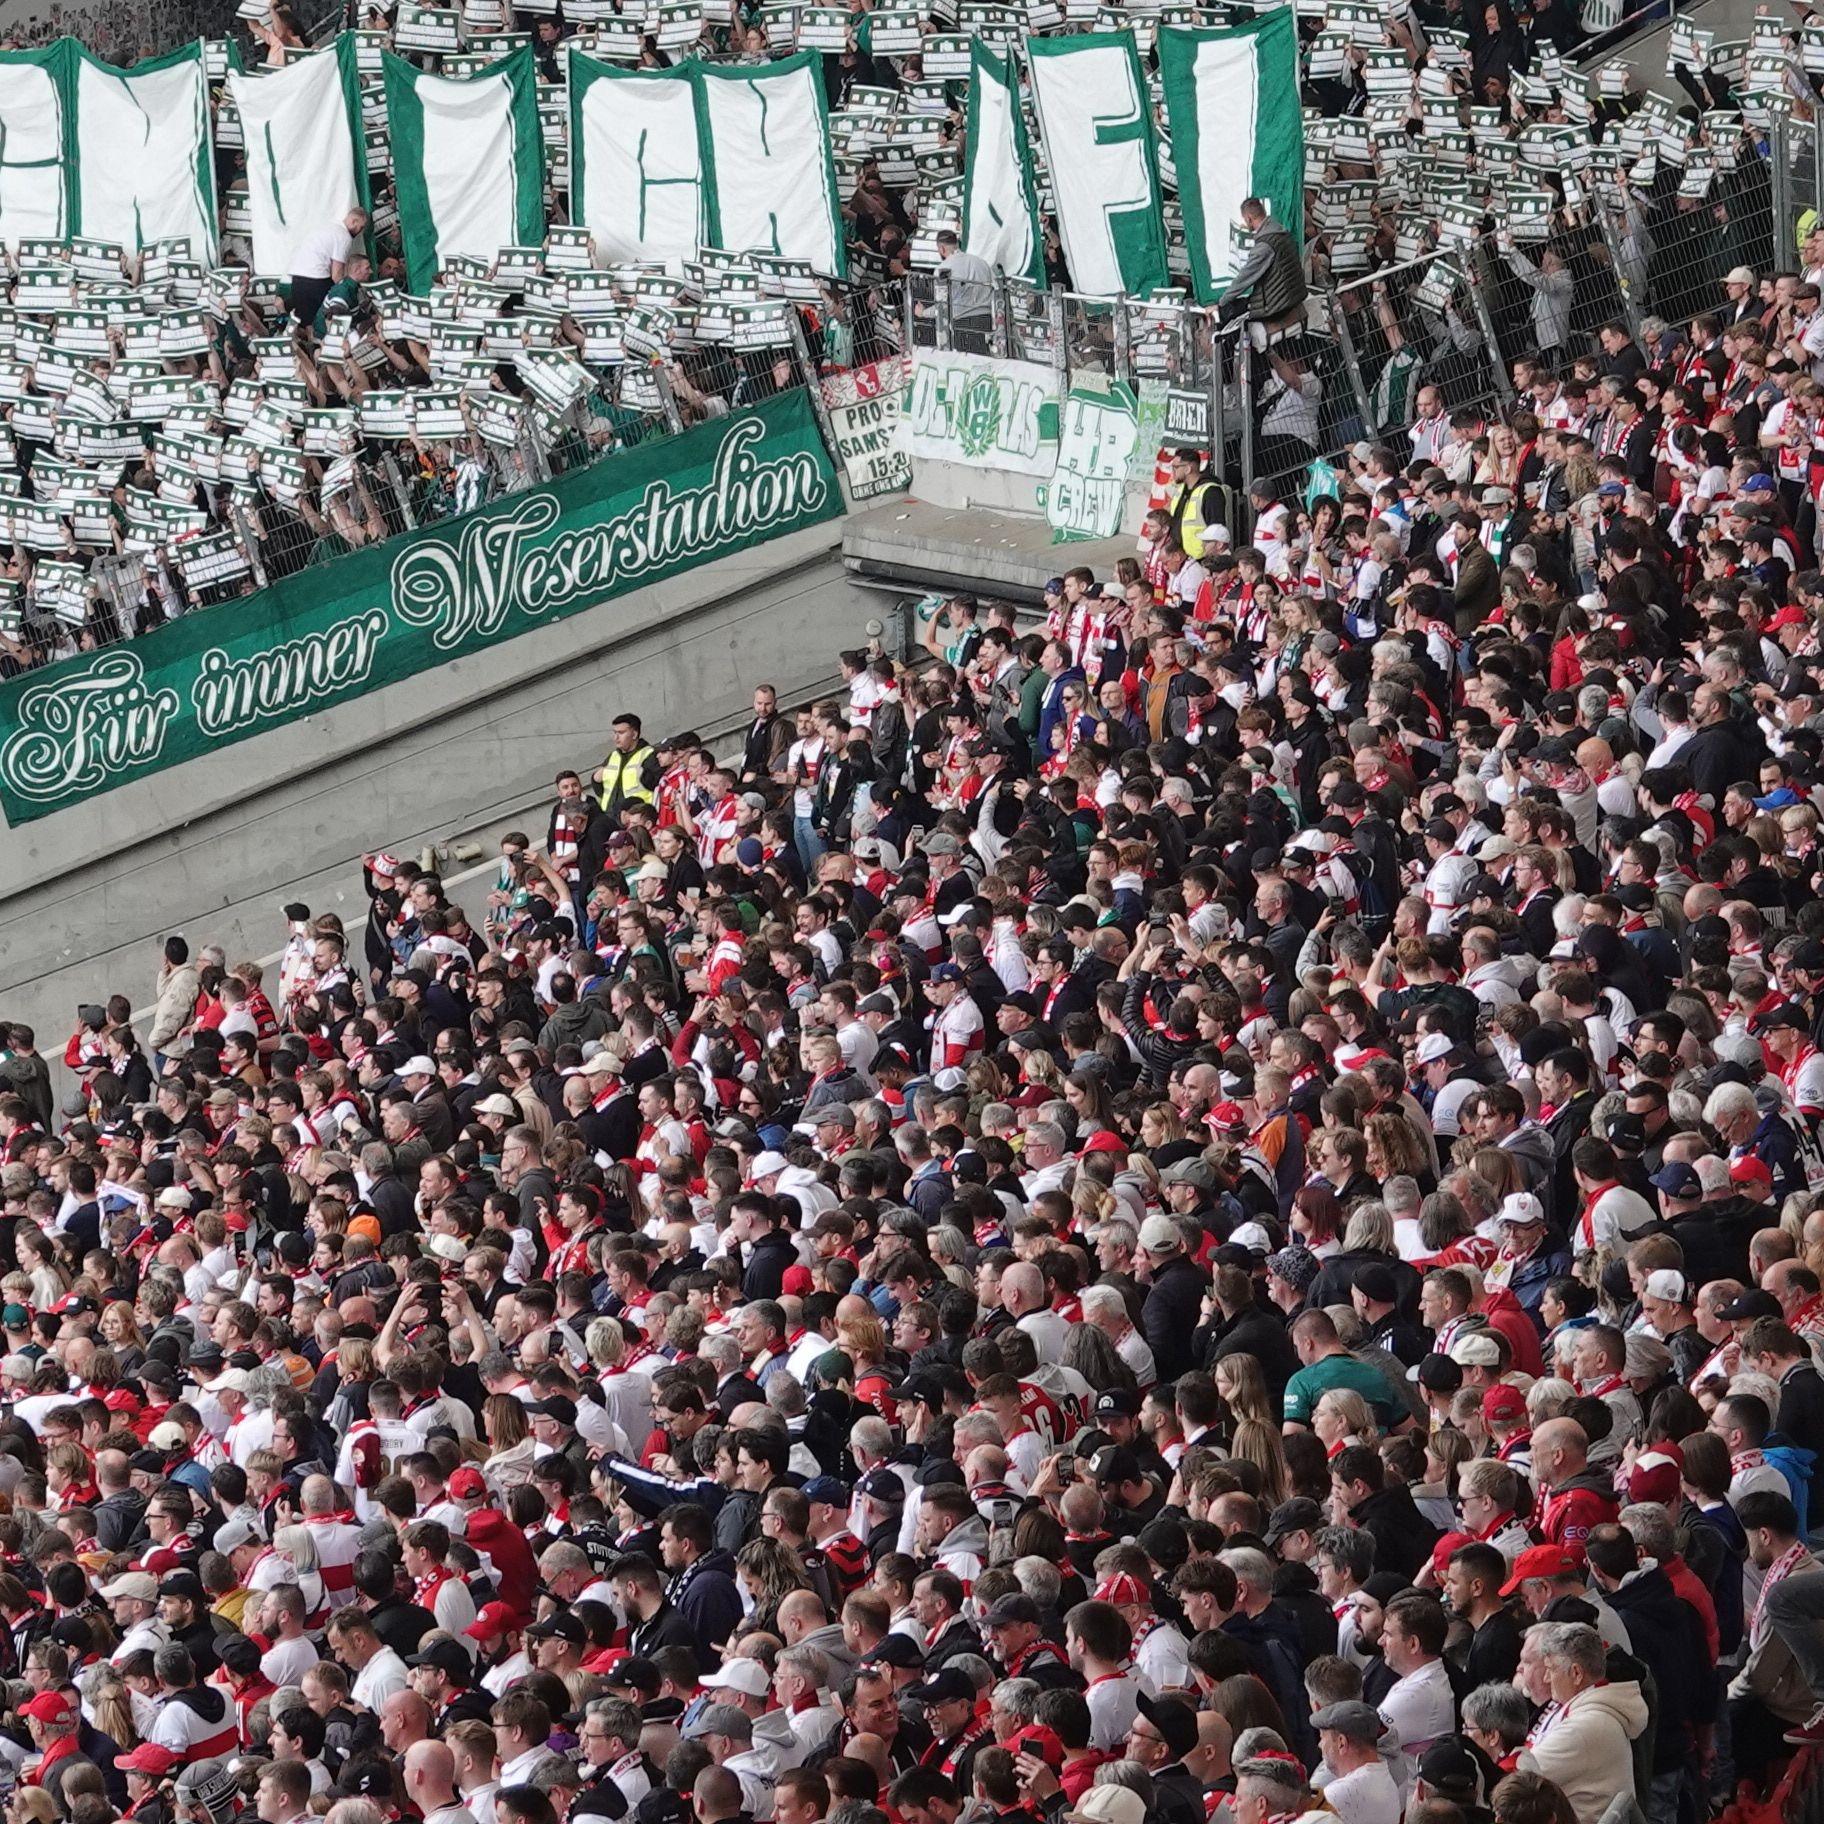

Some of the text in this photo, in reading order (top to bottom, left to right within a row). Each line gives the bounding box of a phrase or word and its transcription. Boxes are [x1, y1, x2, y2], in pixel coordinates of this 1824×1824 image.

[845, 402, 882, 431] PRO
[1058, 398, 1137, 480] HB
[1046, 465, 1125, 539] CREW
[2, 418, 826, 800] Für immer Weserstadion
